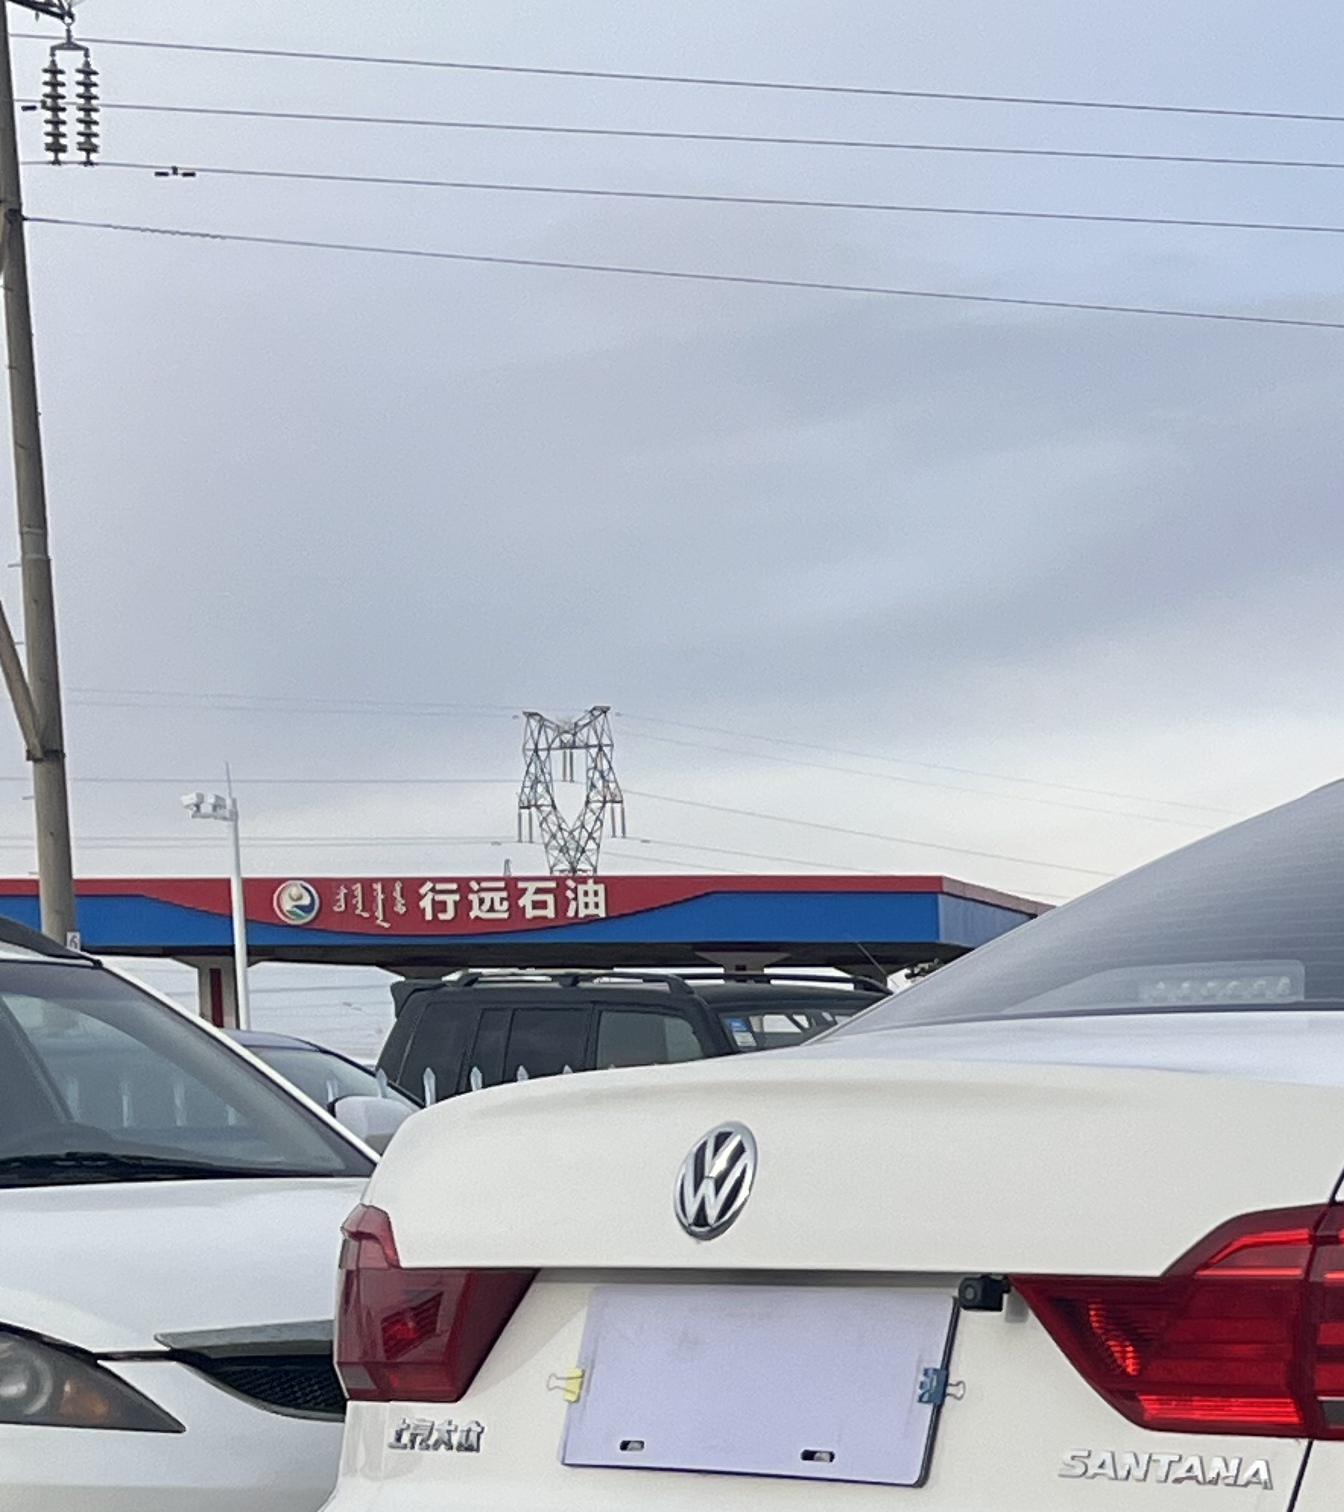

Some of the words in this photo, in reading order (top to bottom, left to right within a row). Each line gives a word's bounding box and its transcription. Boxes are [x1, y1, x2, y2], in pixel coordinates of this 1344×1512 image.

[418, 878, 606, 921] 行远石油
[1058, 1449, 1274, 1490] SANTANA
